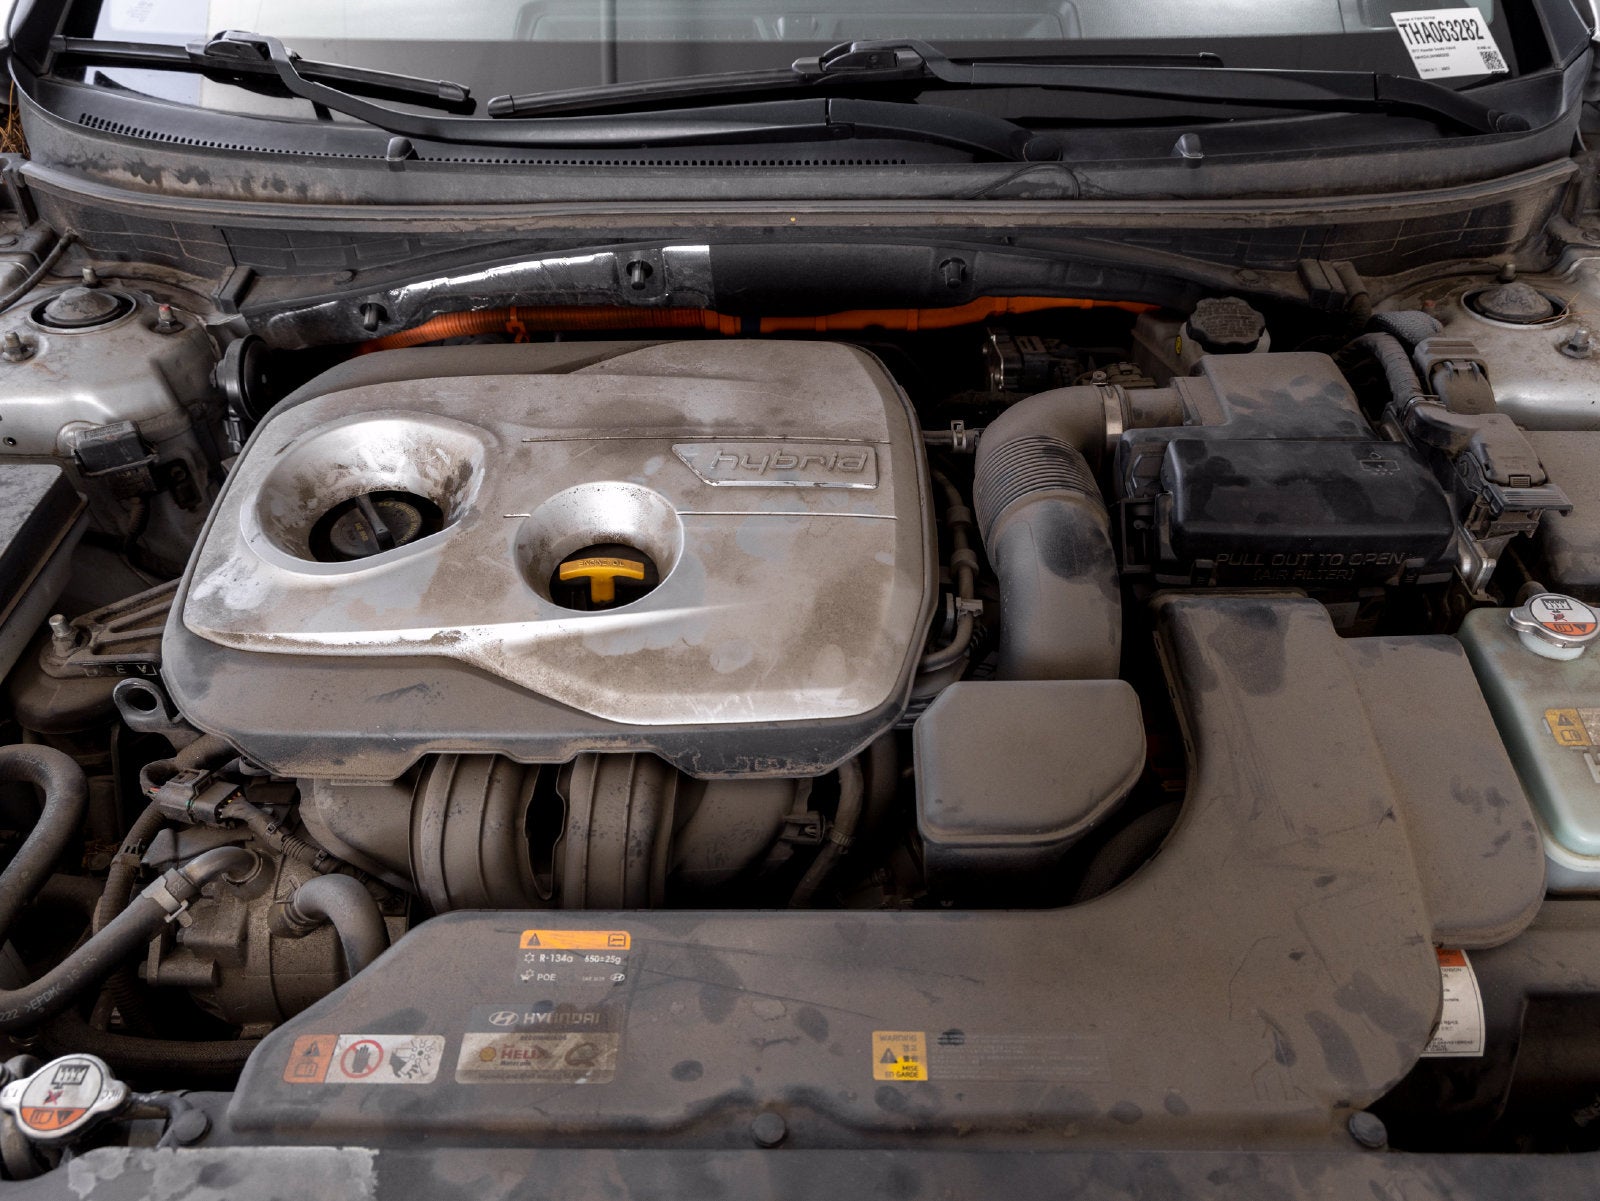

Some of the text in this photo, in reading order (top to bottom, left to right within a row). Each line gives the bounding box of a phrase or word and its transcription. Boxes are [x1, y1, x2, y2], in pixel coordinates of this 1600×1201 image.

[1399, 18, 1484, 45] THA063282
[710, 449, 868, 475] hybrid
[1215, 551, 1403, 566] PULL OUT TO OPEN
[539, 953, 574, 963] R-134a
[536, 973, 557, 982] POE
[523, 1012, 600, 1024] HYUNDAI
[879, 1034, 918, 1042] WARNING
[896, 1071, 919, 1079] GARDE
